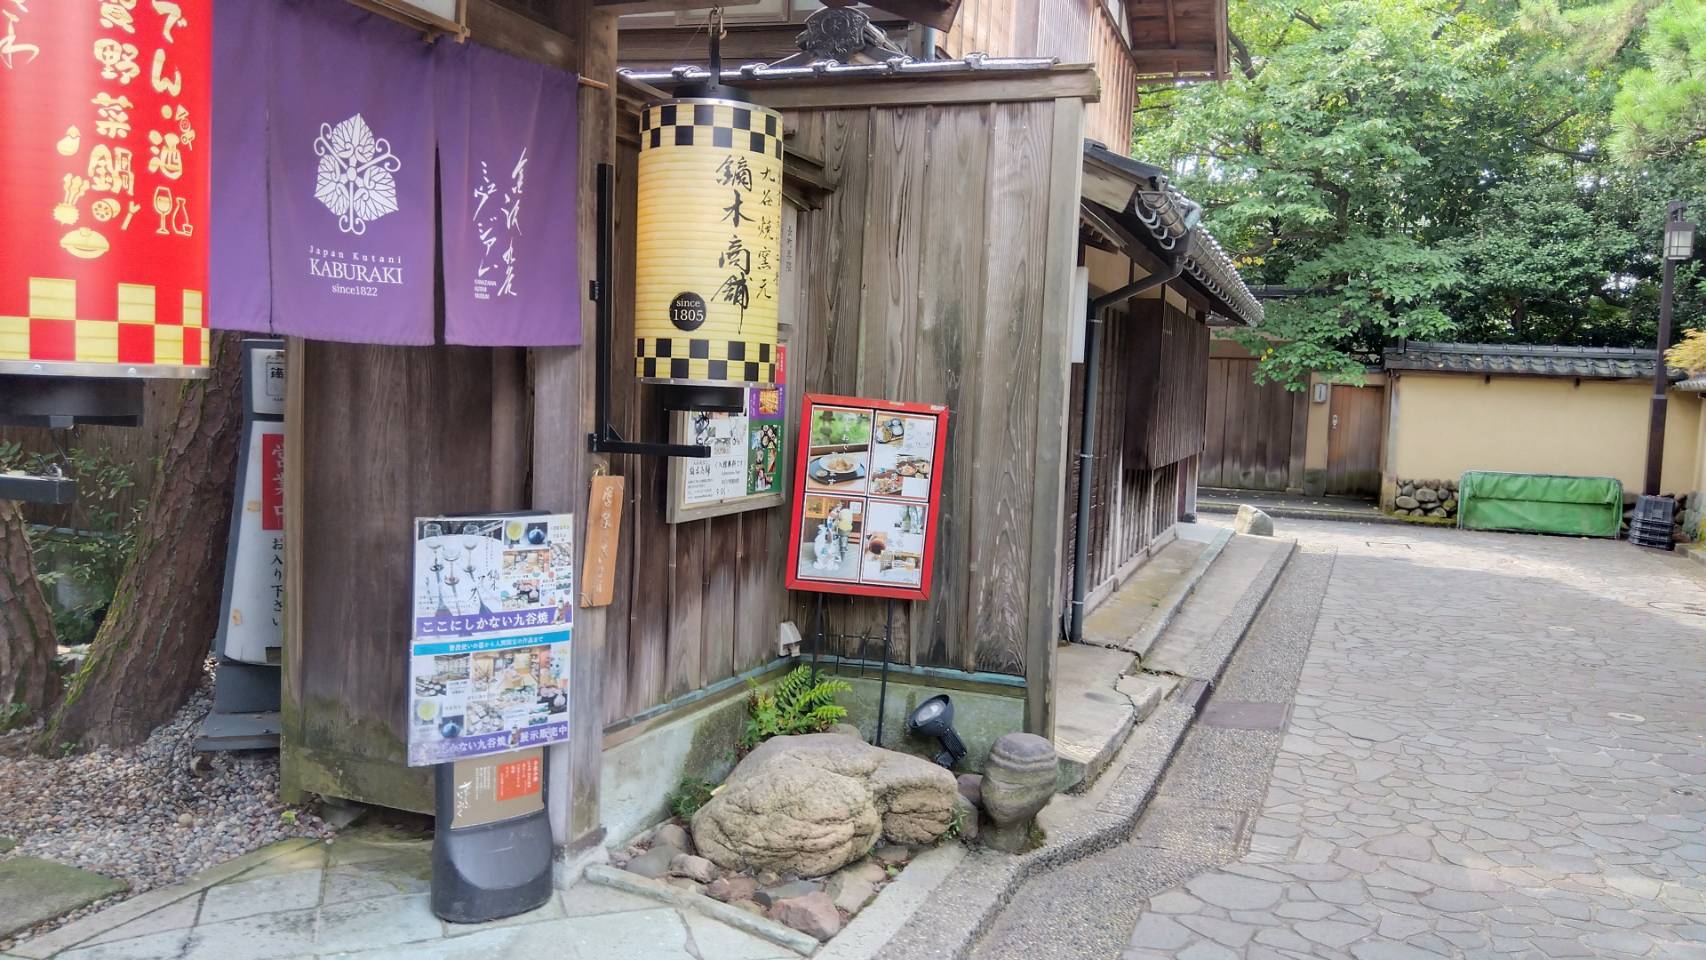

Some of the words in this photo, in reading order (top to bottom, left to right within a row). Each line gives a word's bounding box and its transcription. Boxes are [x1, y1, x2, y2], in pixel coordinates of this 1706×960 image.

[309, 245, 344, 258] Japan
[352, 252, 401, 264] Kutani
[309, 257, 403, 284] KABURAKI
[676, 298, 700, 308] since
[673, 310, 703, 322] 1805
[422, 611, 549, 633] ここにしかない九谷焼
